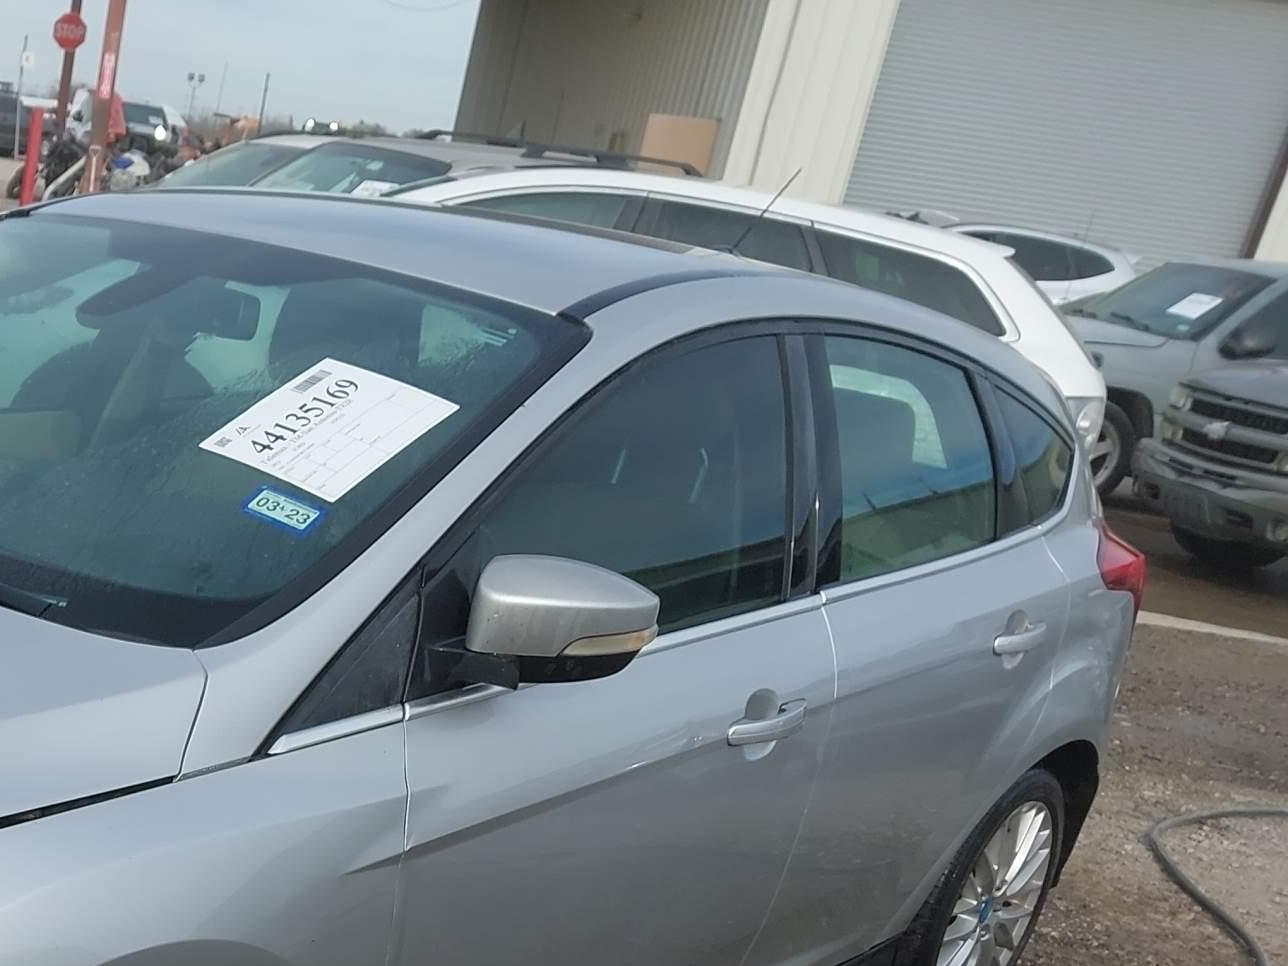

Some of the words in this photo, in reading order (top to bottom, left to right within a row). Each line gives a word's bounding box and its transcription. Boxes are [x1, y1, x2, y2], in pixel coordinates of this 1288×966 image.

[56, 22, 84, 38] STOP
[251, 379, 359, 453] 44135169
[256, 497, 280, 512] 03
[284, 508, 311, 525] 23
